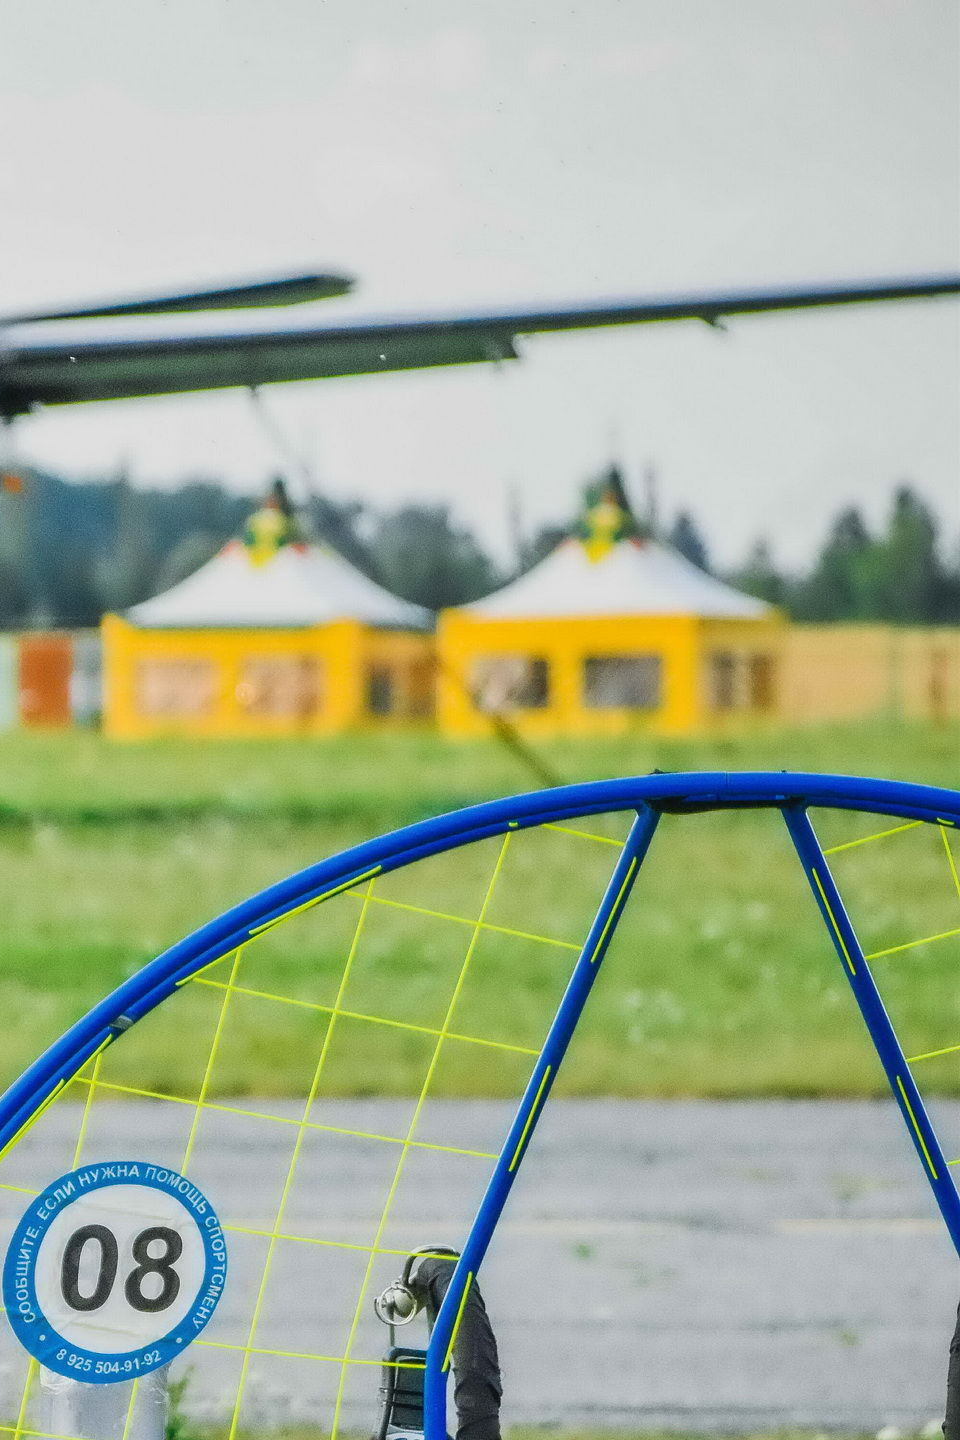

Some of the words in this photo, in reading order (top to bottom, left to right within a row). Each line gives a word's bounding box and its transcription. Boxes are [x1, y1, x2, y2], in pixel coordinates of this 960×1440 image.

[15, 1225, 44, 1323] СООБЩИТЕ,
[36, 1181, 75, 1221] ЕСЛИ
[78, 1165, 140, 1187] НУЖНА
[145, 1166, 208, 1215] ПОМОЩЬ
[192, 1215, 226, 1329] СПОРТСМЕНУ
[60, 1224, 183, 1313] 08
[56, 1348, 68, 1361] 8
[67, 1352, 92, 1373] 925
[94, 1349, 162, 1374] 504-91-92
